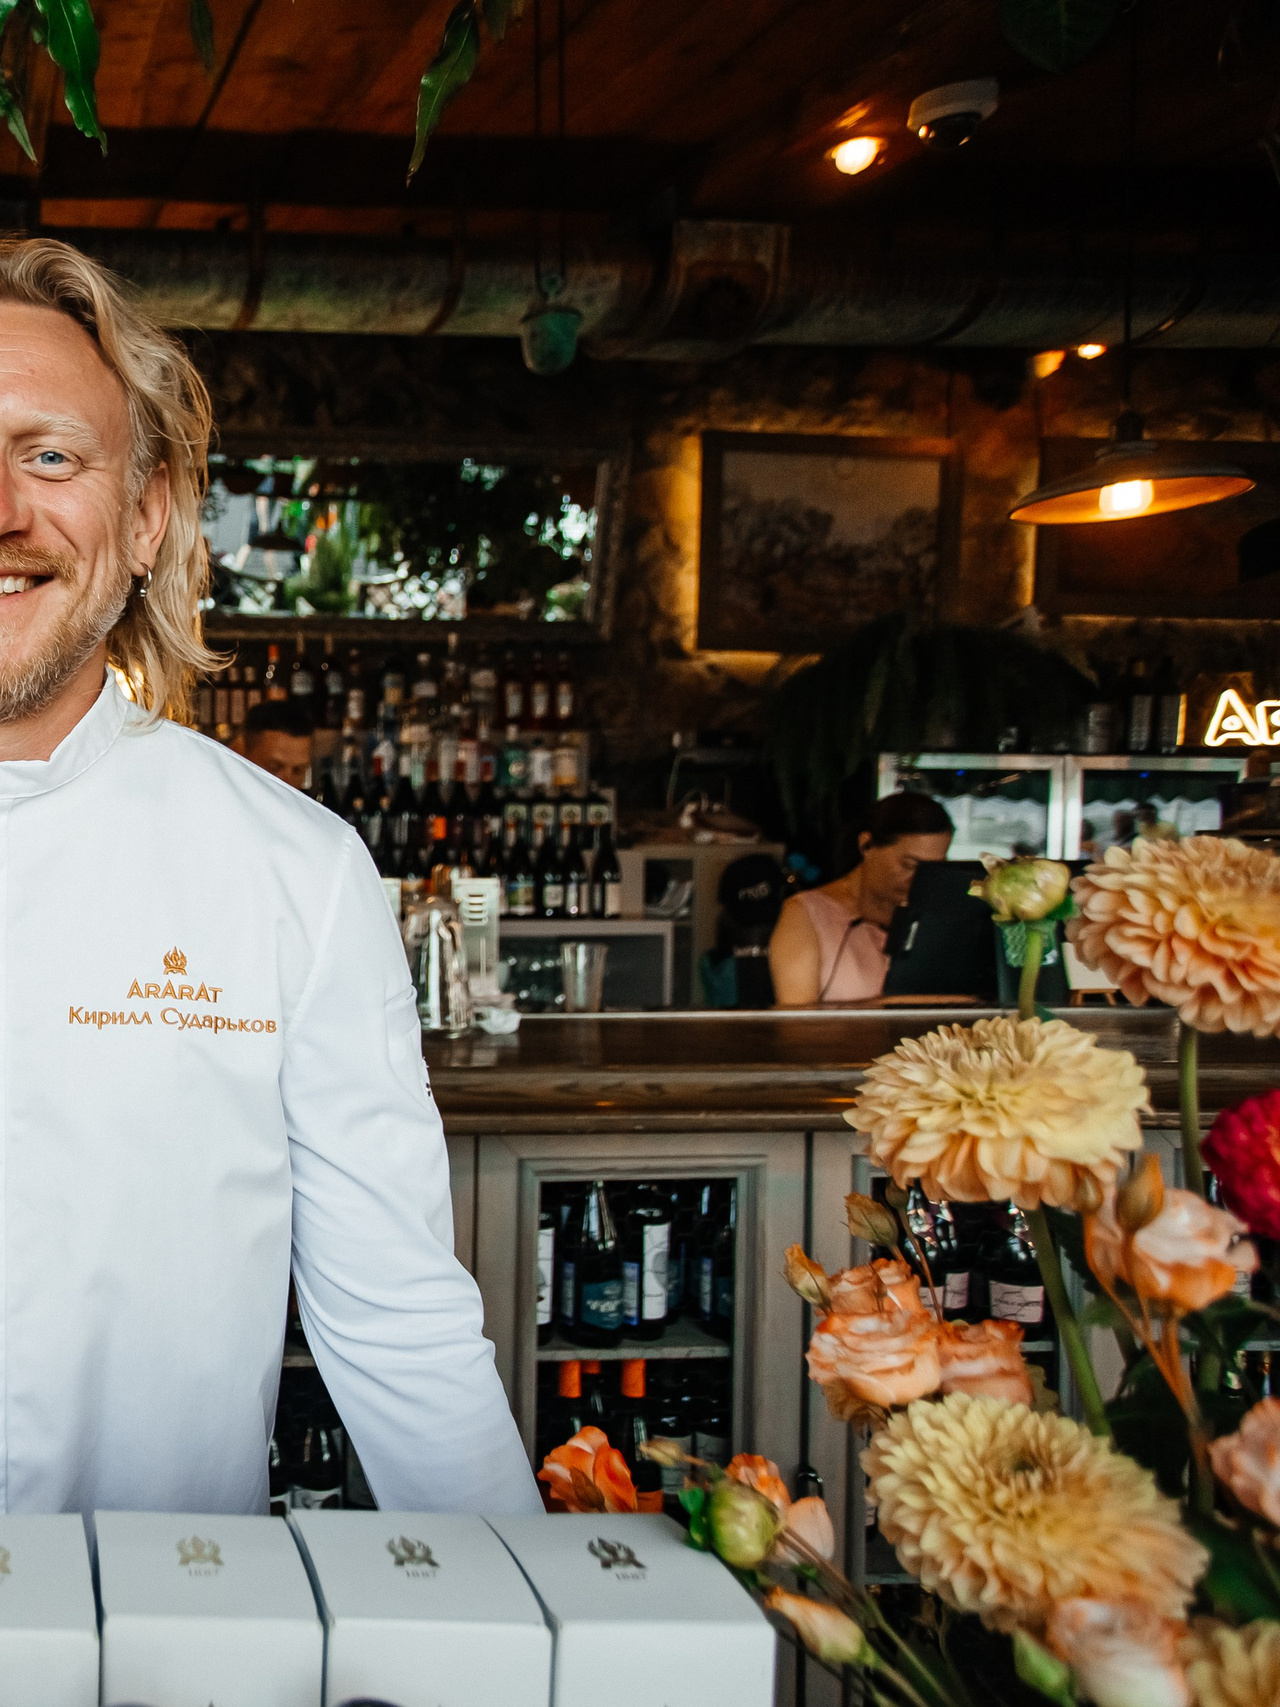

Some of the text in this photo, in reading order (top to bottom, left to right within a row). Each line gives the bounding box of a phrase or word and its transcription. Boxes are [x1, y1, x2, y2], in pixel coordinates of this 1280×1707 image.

[127, 978, 223, 1003] ARARAT
[69, 1006, 277, 1034] Кирилл Сударьков
